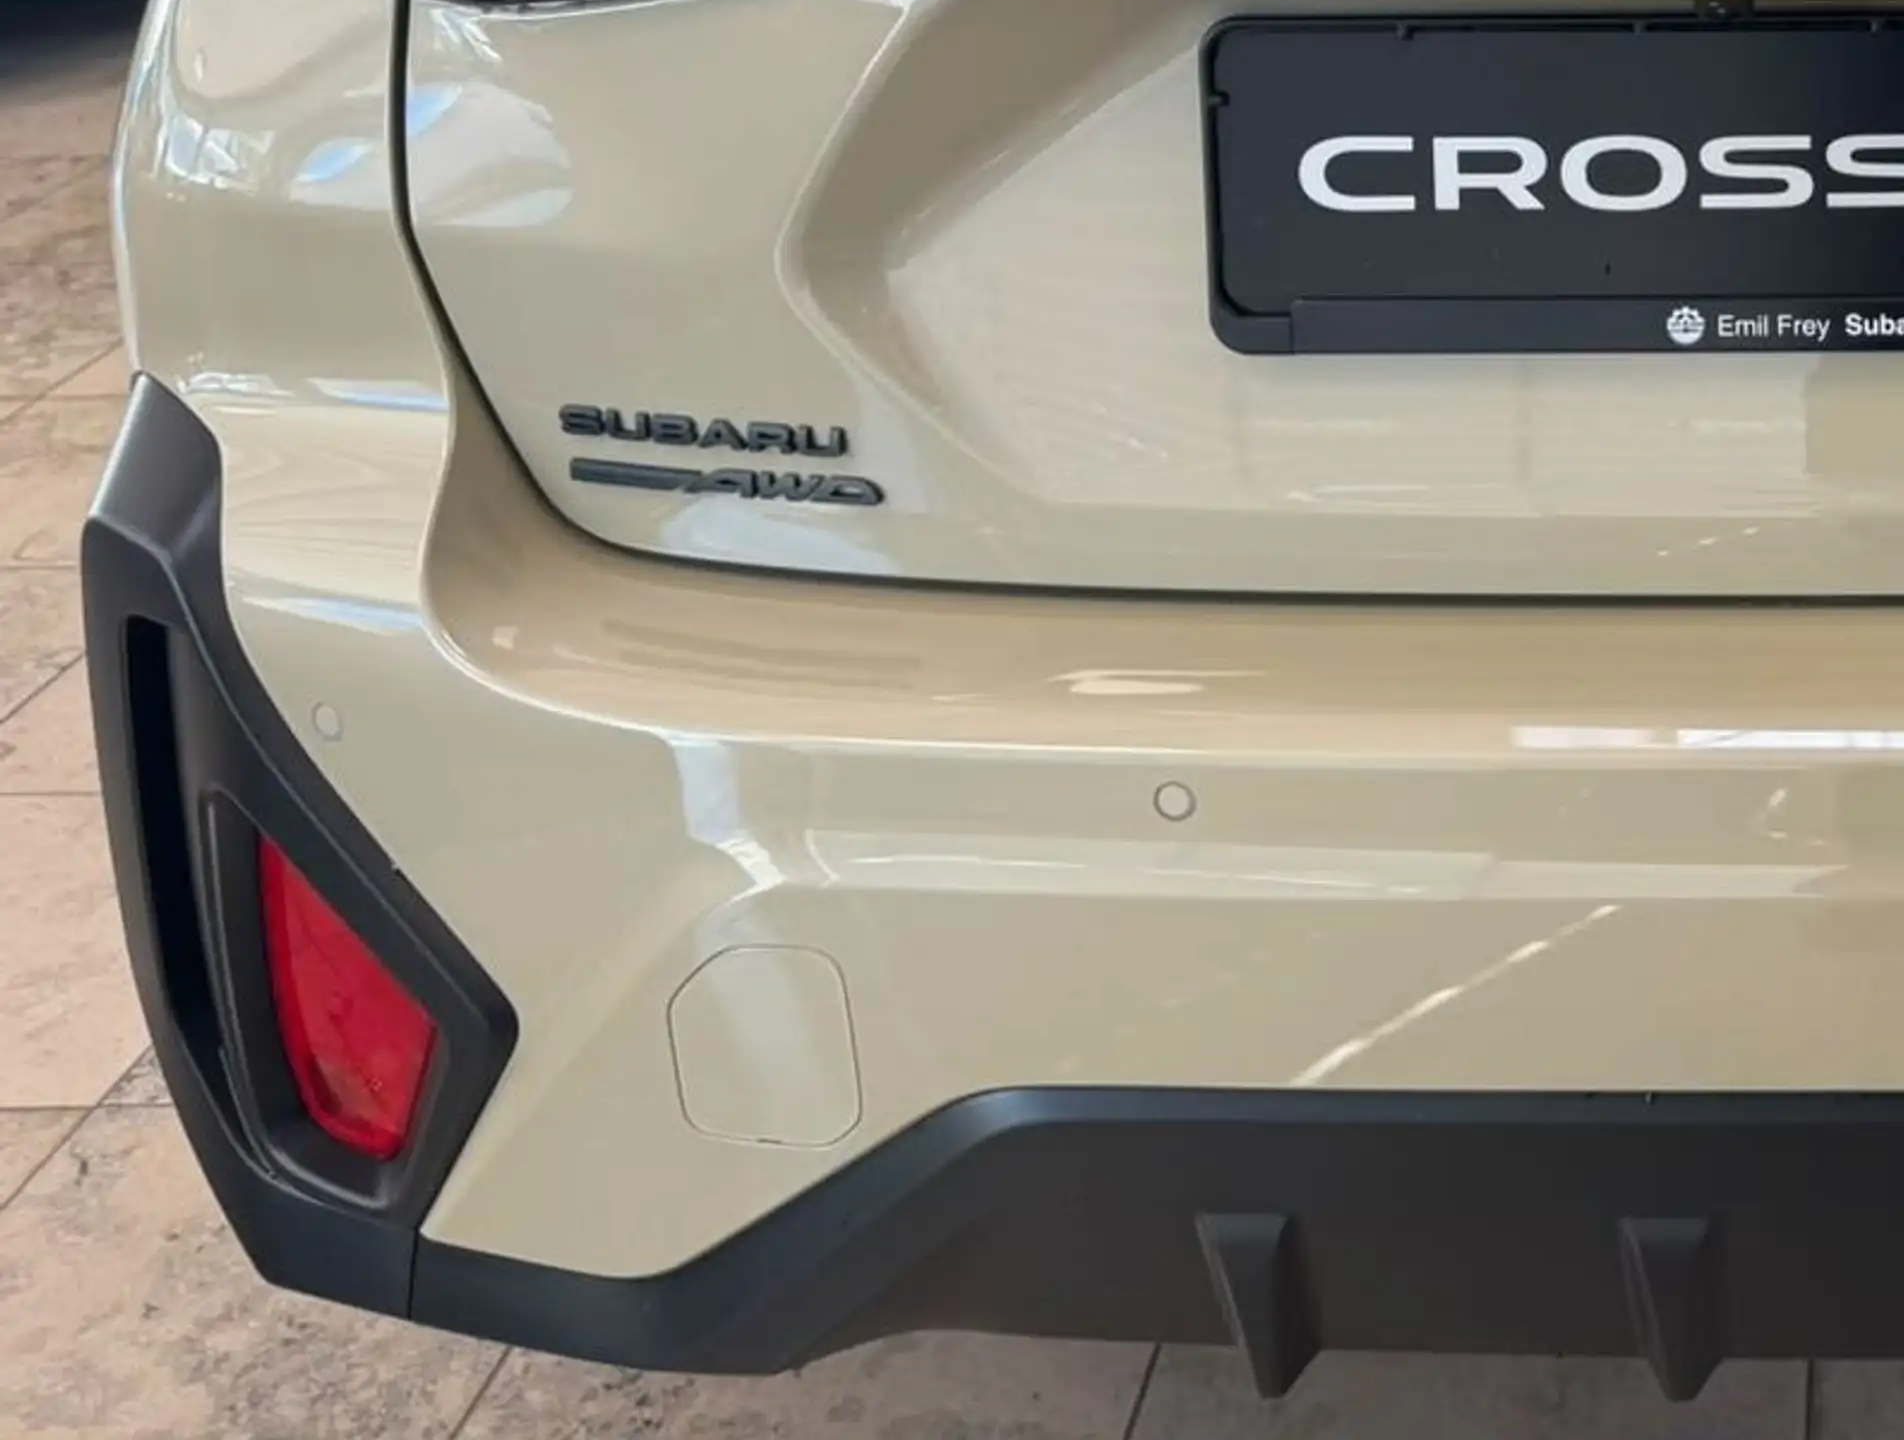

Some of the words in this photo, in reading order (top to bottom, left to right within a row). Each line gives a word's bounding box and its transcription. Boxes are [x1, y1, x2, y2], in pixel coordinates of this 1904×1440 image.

[1716, 312, 1769, 337] Emil
[1776, 312, 1831, 343] Frey
[558, 403, 848, 458] SUBARU
[684, 467, 886, 506] AWD
